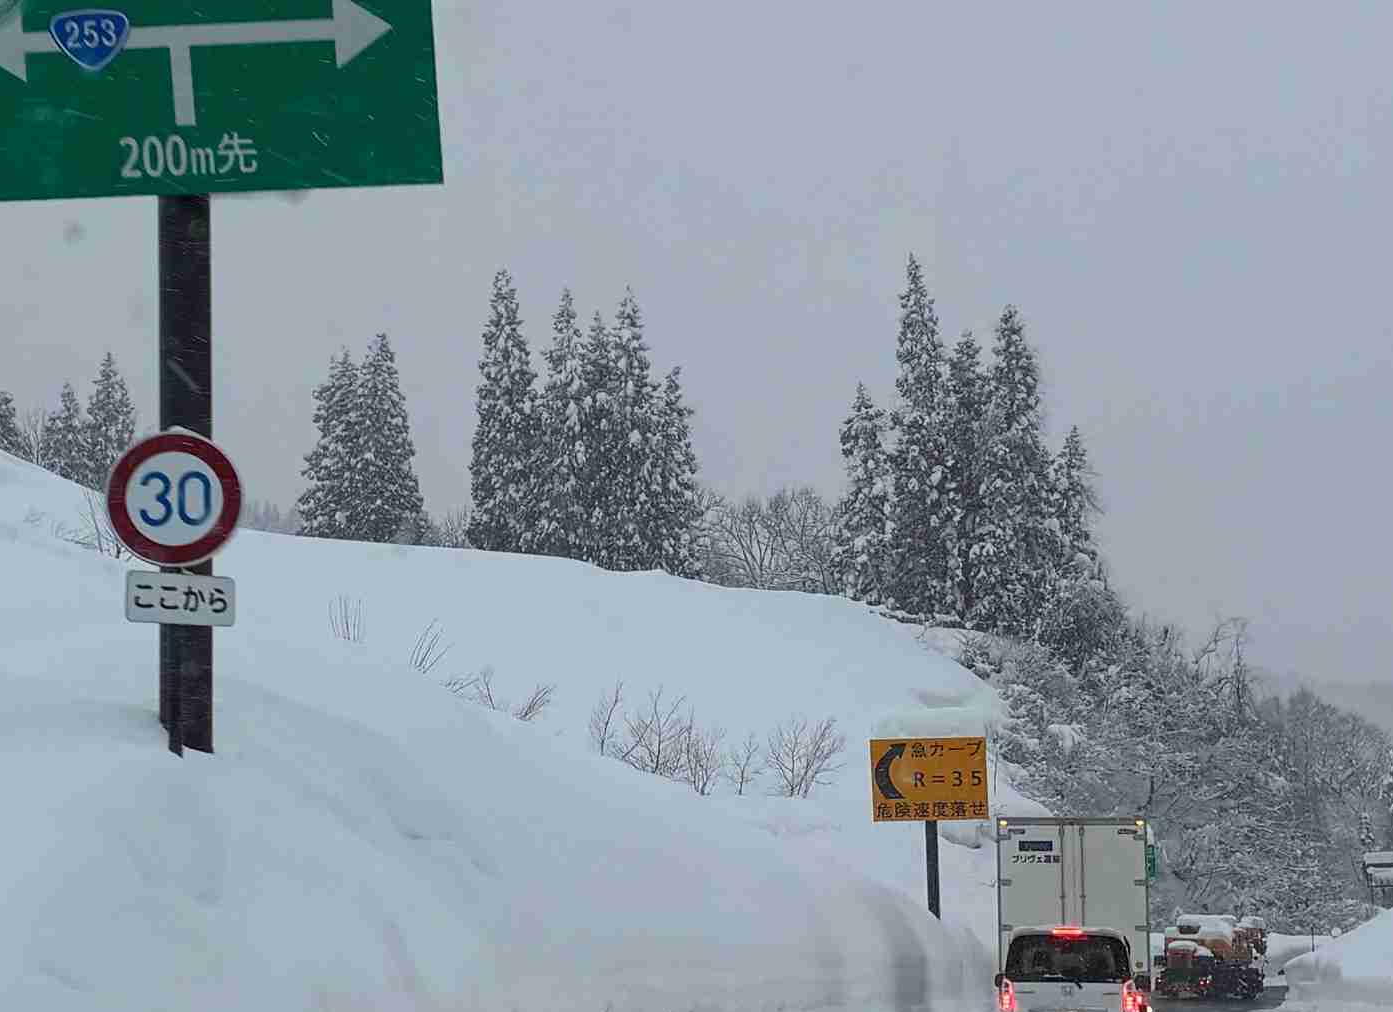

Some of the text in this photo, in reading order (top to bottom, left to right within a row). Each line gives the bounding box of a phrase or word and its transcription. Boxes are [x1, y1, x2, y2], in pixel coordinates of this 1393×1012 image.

[64, 18, 117, 49] 253
[119, 131, 258, 179] 200m先
[139, 471, 211, 526] 30
[134, 583, 228, 614] ここから
[910, 740, 984, 760] 急カーブ
